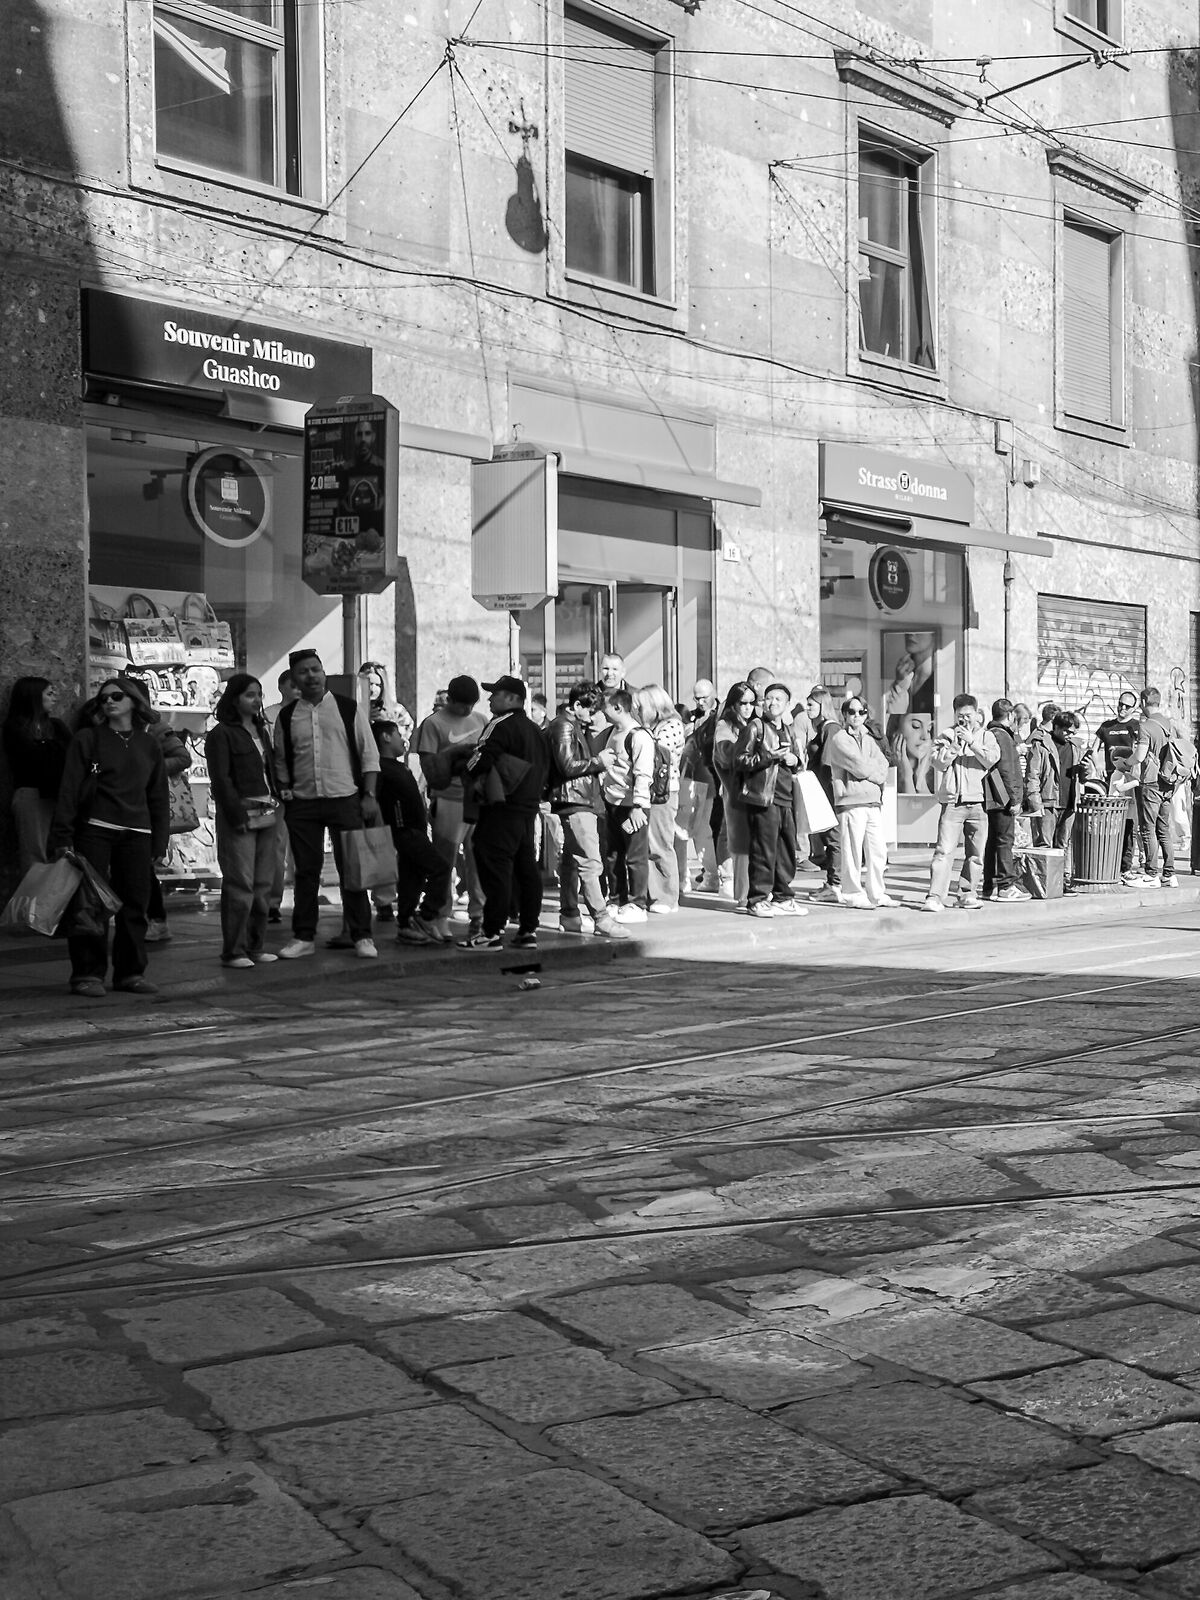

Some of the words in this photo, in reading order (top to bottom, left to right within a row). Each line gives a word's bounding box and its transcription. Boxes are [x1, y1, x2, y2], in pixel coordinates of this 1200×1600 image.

[163, 320, 251, 357] Souvenir
[252, 338, 316, 370] Milano
[202, 358, 281, 391] Guashco
[858, 466, 899, 491] Strass
[910, 477, 948, 501] donna
